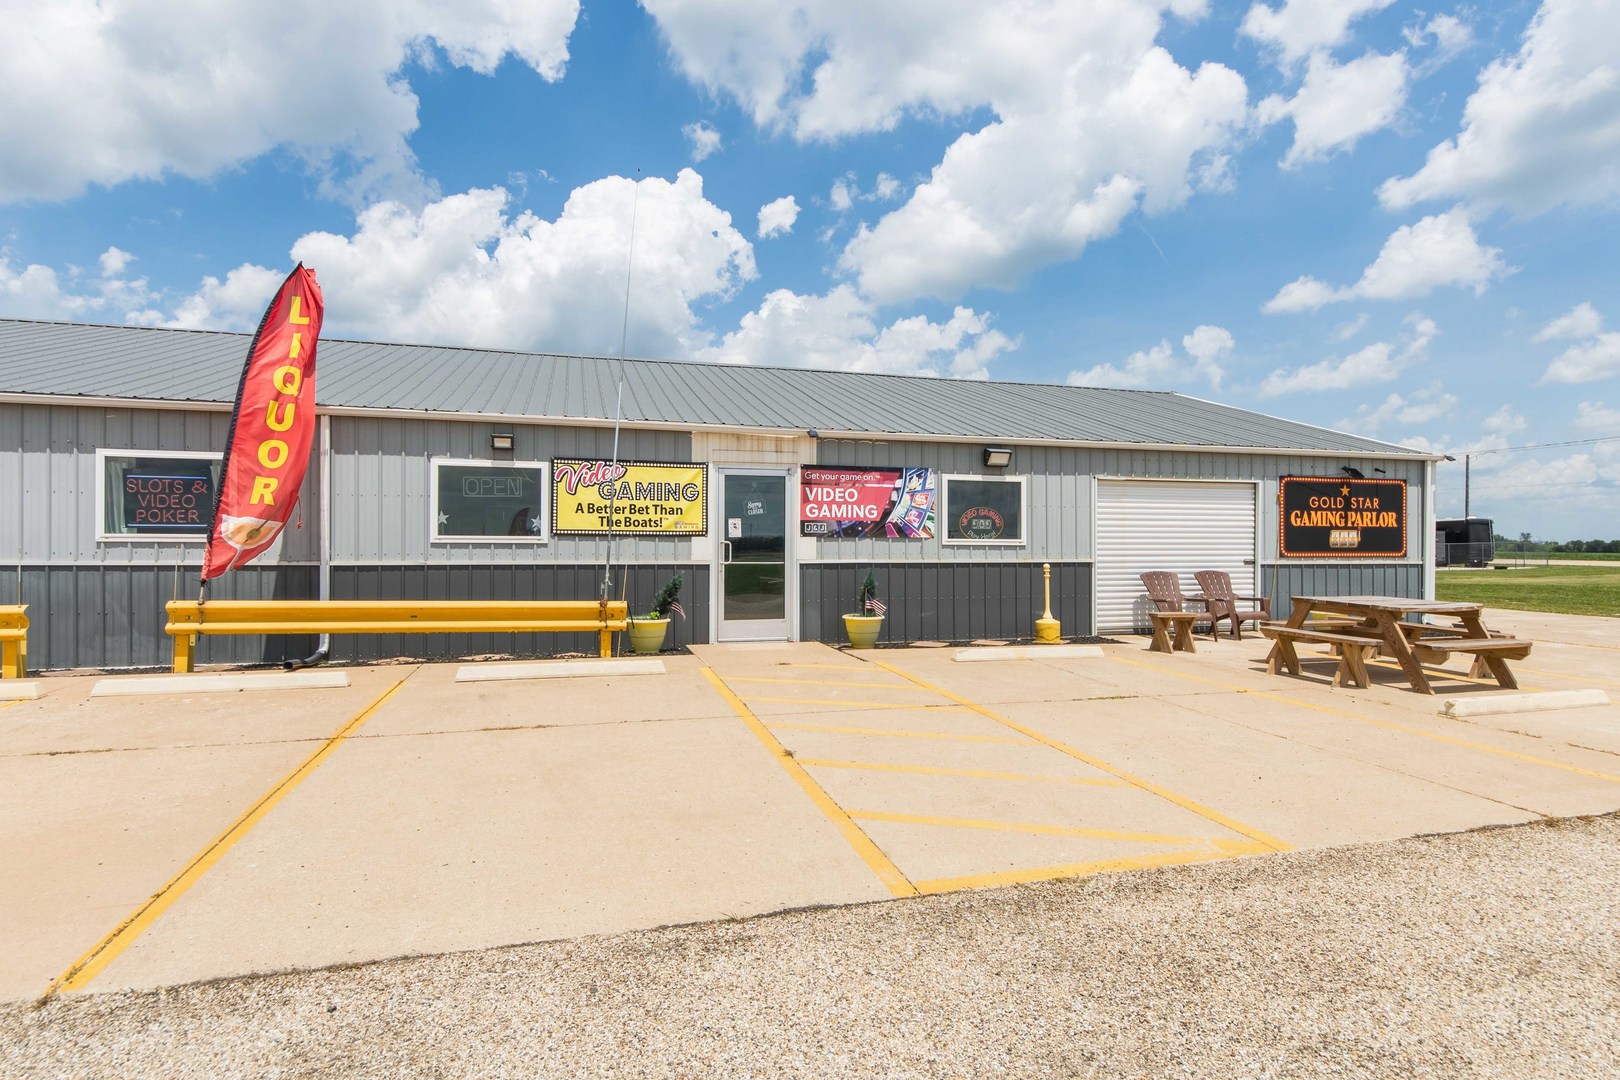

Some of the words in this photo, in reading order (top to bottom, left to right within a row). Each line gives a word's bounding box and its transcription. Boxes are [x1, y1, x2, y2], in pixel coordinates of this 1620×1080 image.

[249, 295, 310, 506] LIQUOR
[555, 461, 627, 495] Video
[805, 471, 820, 480] Get
[820, 473, 838, 482] your
[840, 474, 861, 482] game
[126, 479, 184, 493] SLOTS
[191, 480, 208, 494] &
[465, 478, 520, 495] OPEN
[598, 481, 699, 501] GAMING
[138, 494, 195, 508] VIDEO
[805, 487, 859, 502] VIDEO
[575, 502, 584, 514] A
[629, 504, 650, 515] Bet
[652, 504, 683, 516] Than
[1309, 496, 1345, 508] GOLD
[1351, 497, 1379, 509] STAR
[136, 509, 200, 523] POKER
[805, 503, 878, 519] GAMING
[961, 509, 977, 526] VIDEO
[978, 508, 1002, 527] GAMING
[598, 516, 621, 527] The
[624, 516, 663, 528] Boats!
[1290, 510, 1346, 527] GAMING
[1347, 511, 1398, 528] PARLOR
